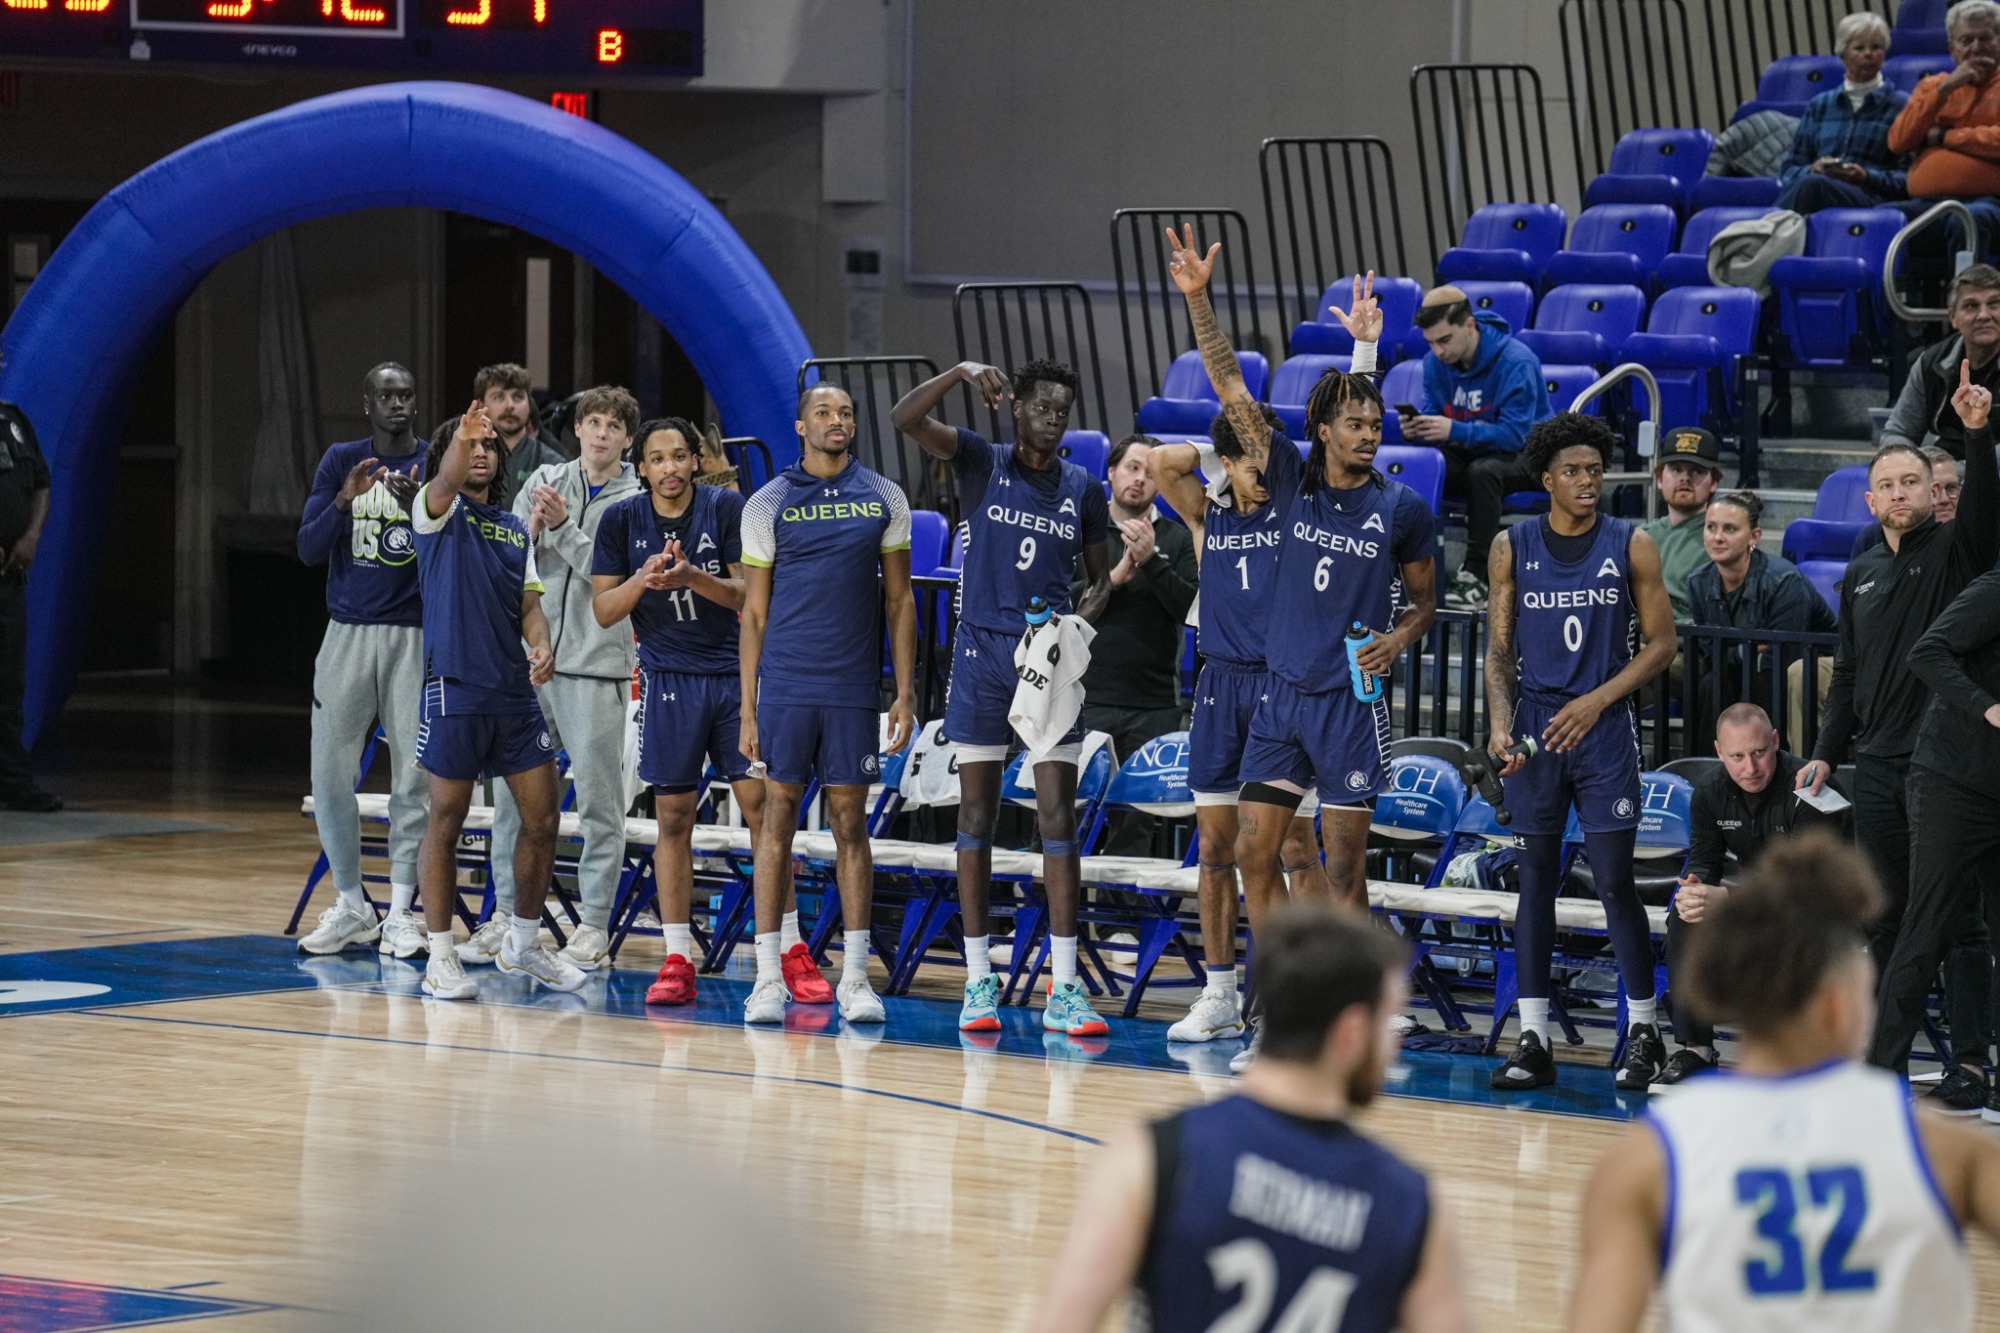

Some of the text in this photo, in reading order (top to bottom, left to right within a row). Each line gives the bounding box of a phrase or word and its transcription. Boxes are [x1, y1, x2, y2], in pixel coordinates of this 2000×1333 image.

[600, 31, 621, 61] B
[463, 505, 526, 549] EENS
[782, 502, 883, 522] QUEENS
[987, 504, 1076, 541] QUEENS
[352, 518, 382, 559] US
[1015, 536, 1037, 571] 9
[1294, 521, 1379, 559] QUEENS
[1235, 556, 1250, 590] 1
[1314, 556, 1334, 592] 6
[668, 588, 698, 622] 11
[1523, 587, 1619, 609] QUEENS
[1563, 614, 1583, 652] 0
[1158, 774, 1188, 782] Healthcar
[1395, 798, 1428, 809] Healthcare
[1402, 806, 1426, 816] System
[1732, 1164, 1878, 1297] 32
